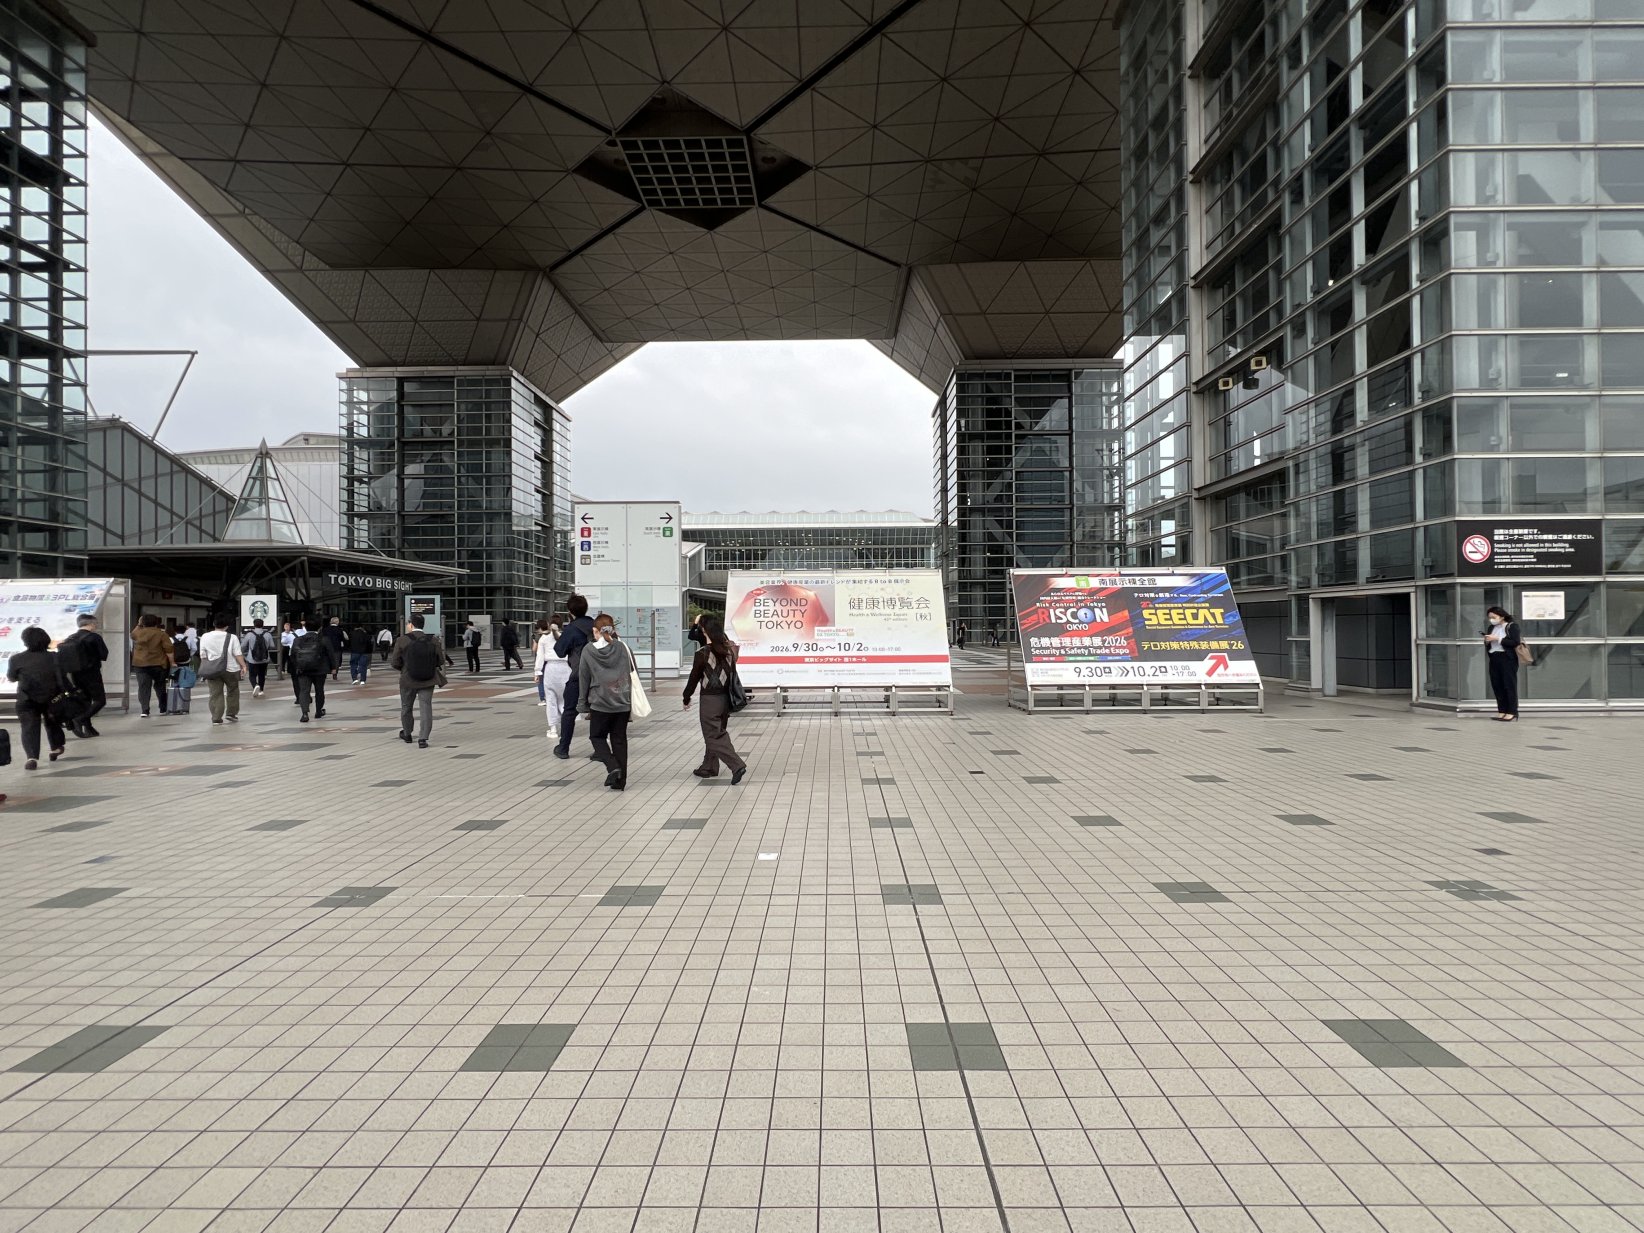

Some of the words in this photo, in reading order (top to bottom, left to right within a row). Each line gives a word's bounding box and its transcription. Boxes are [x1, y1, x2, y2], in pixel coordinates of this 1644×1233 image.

[328, 574, 373, 588] TOKYO
[375, 578, 392, 590] BIG
[393, 580, 413, 592] SIGHT
[1098, 577, 1158, 587] 南展示棟全館
[753, 598, 808, 607] BEYOND
[848, 596, 931, 610] 健康博覧会
[753, 609, 808, 618] BEAUTY
[1037, 608, 1109, 623] RISCON
[1142, 608, 1224, 625] SEECAT
[757, 620, 804, 630] TOKYO
